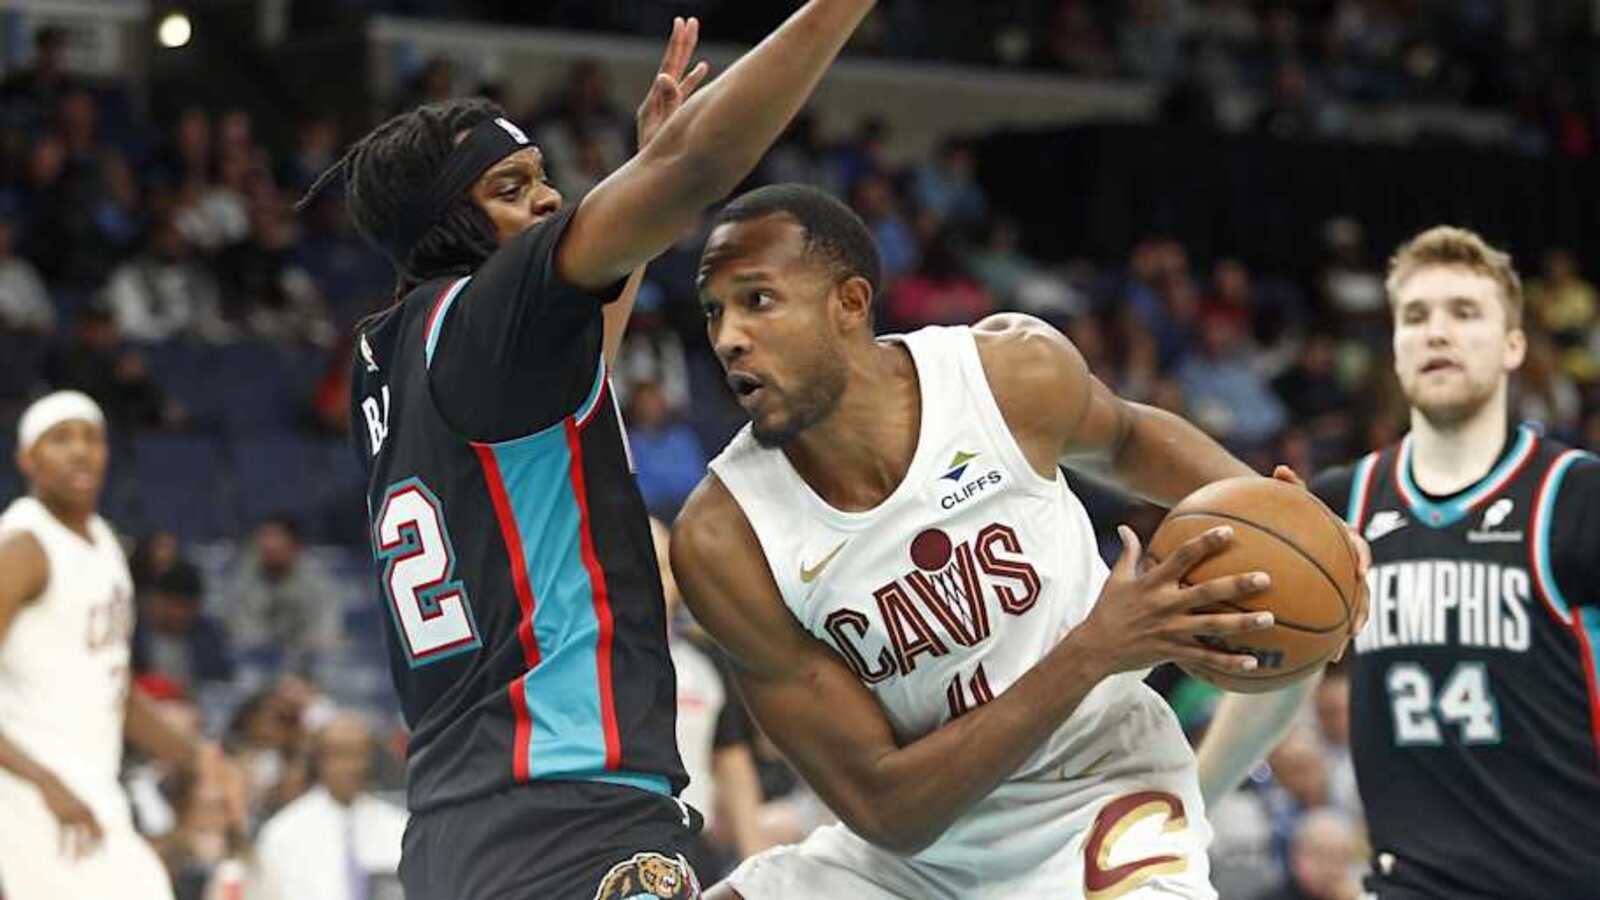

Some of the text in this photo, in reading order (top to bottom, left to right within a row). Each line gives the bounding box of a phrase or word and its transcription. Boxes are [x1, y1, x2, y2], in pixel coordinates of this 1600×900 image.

[941, 470, 1003, 510] CLIFFS
[824, 522, 1042, 685] CAVS
[1354, 560, 1531, 654] MEMPHIS
[1386, 660, 1501, 746] 24
